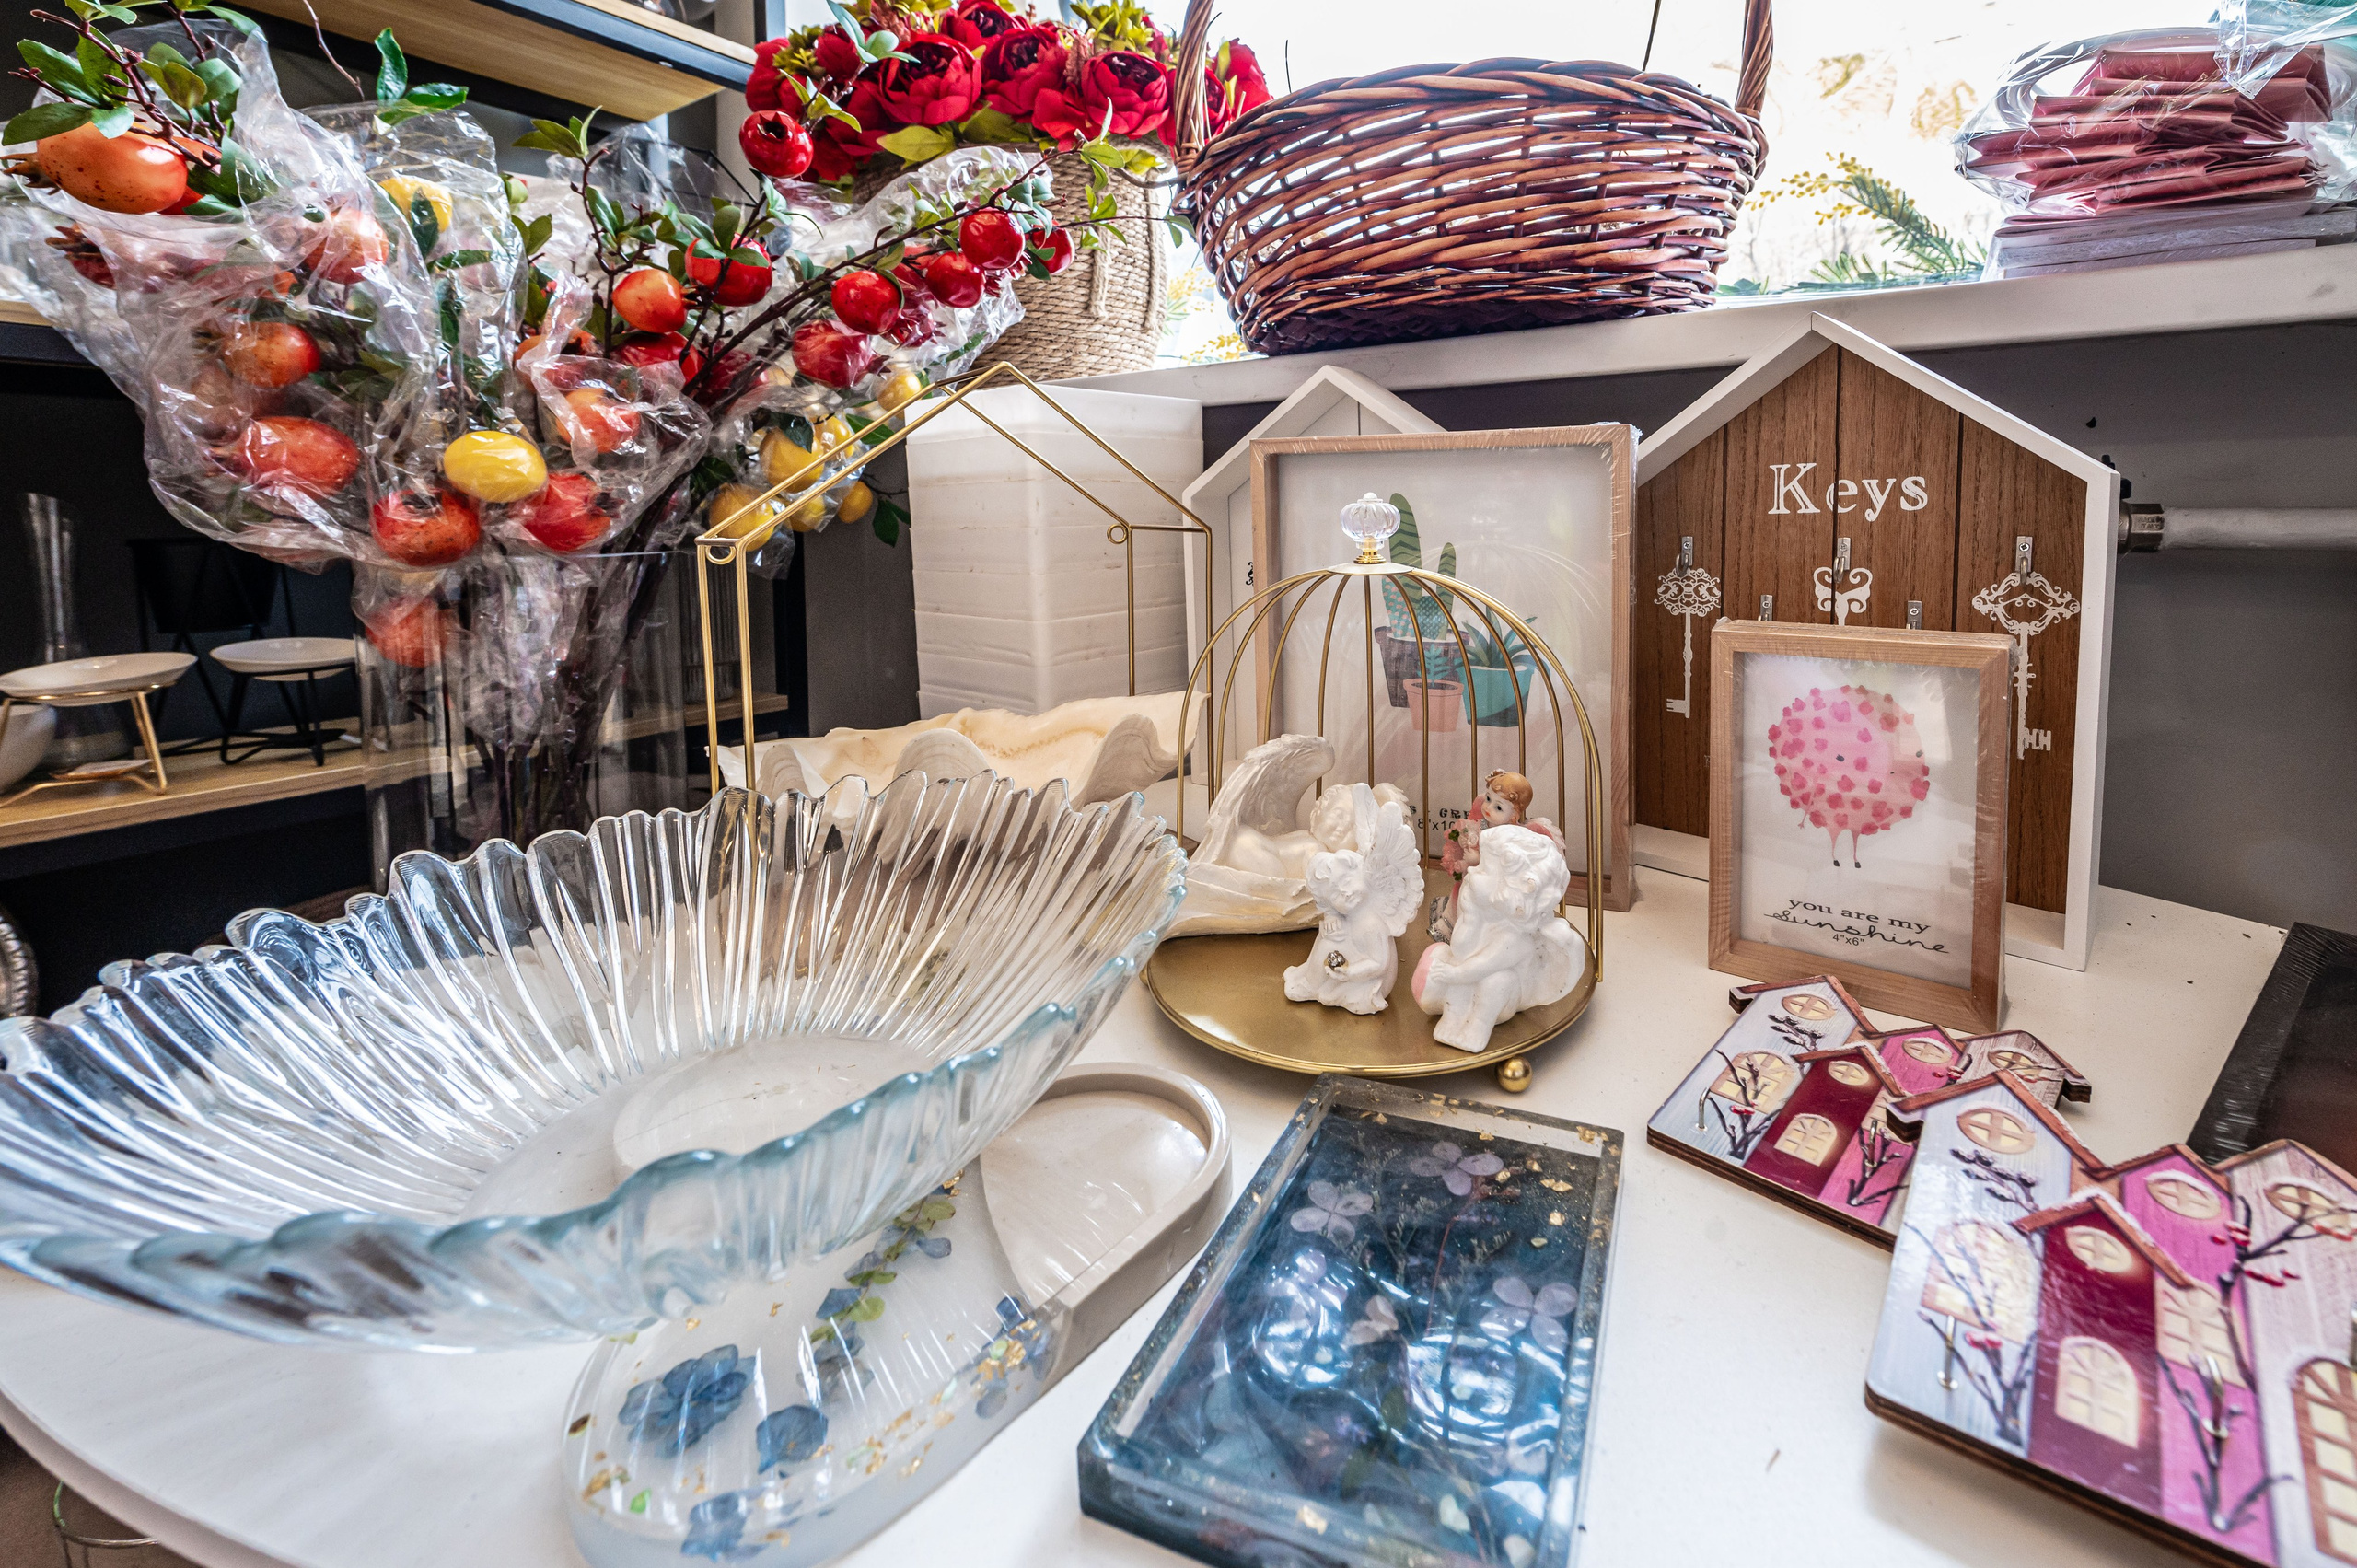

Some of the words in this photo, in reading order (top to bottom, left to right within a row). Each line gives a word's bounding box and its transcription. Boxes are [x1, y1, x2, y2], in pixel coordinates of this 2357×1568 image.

[1768, 462, 1929, 522] Keys
[1787, 899, 1833, 915] you
[1840, 908, 1879, 923] are
[1888, 917, 1932, 935] my
[1832, 933, 1864, 947] 4"x6"
